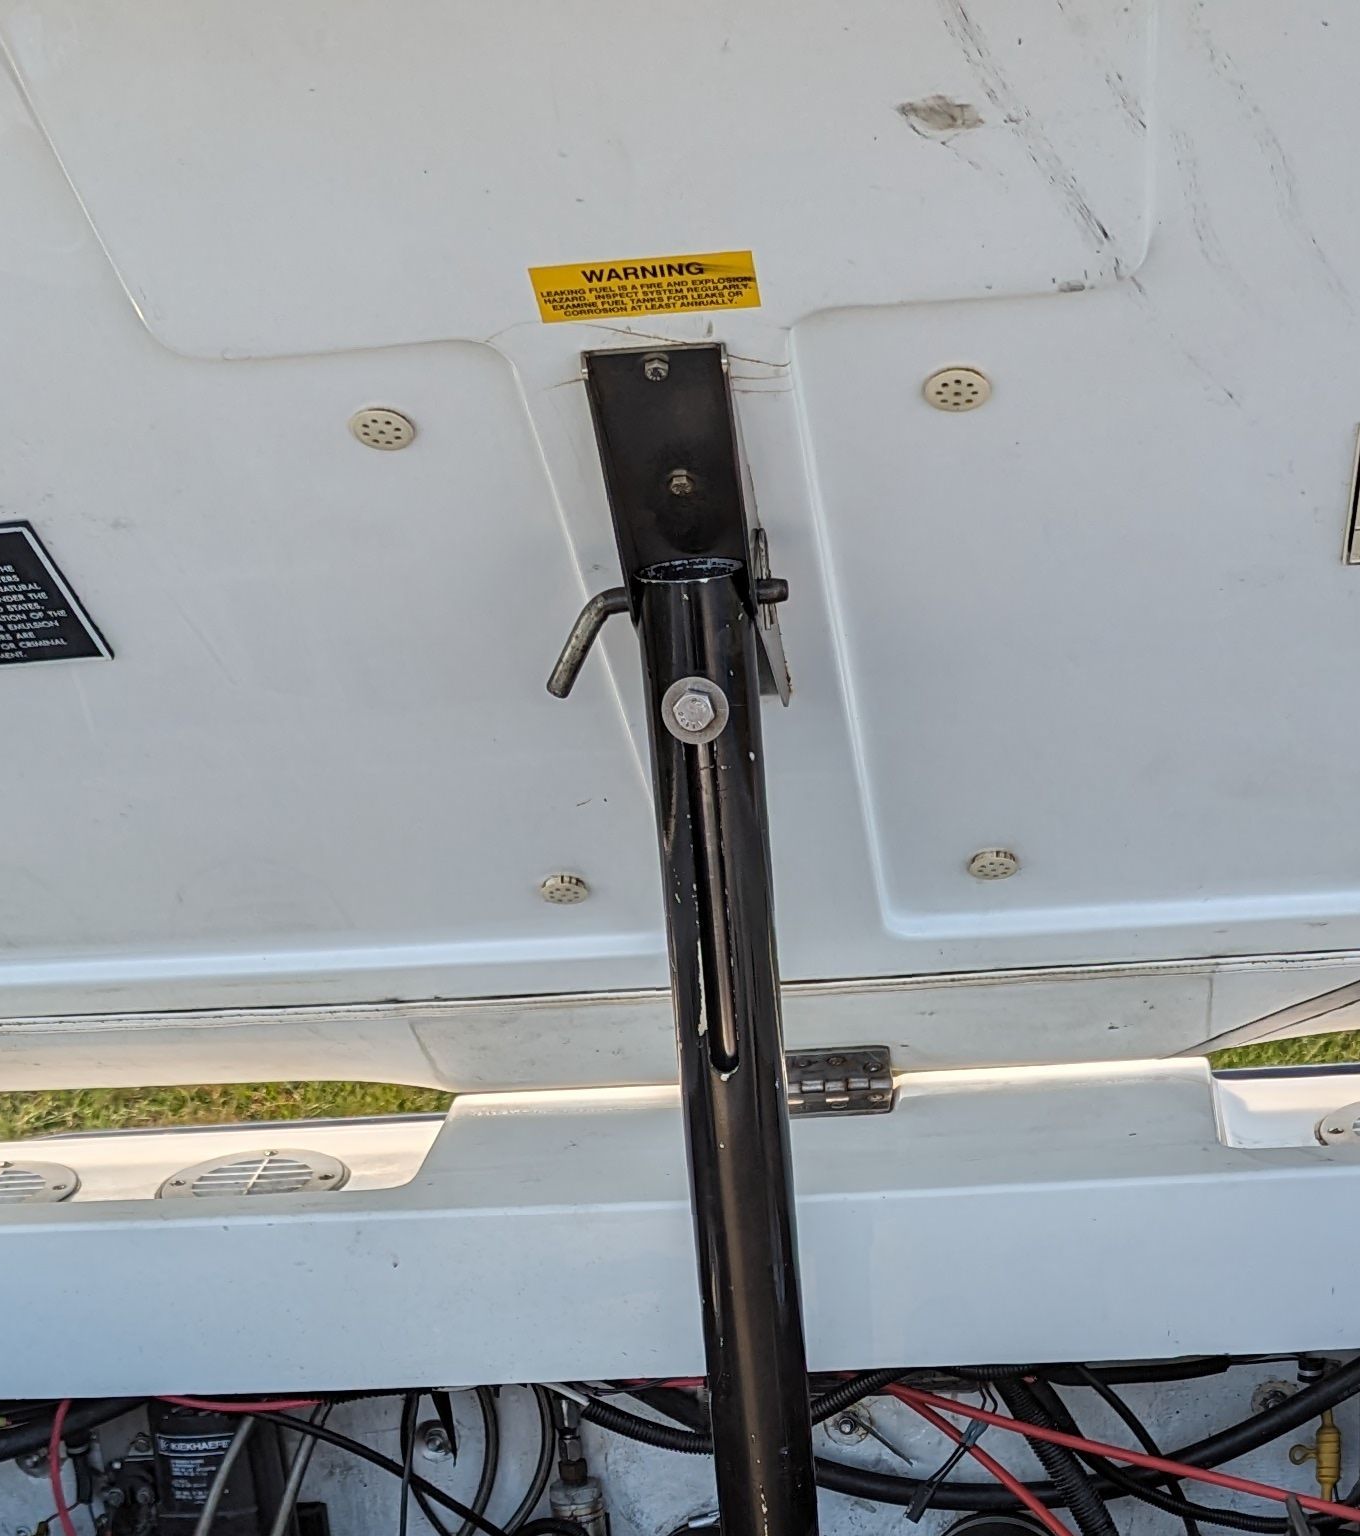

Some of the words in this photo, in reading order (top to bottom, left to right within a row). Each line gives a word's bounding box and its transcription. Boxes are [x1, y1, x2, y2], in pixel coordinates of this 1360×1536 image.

[582, 262, 705, 283] WARNING
[540, 289, 586, 297] LEAKING
[691, 276, 752, 286] EXPLOSION
[594, 292, 640, 300] INSPECT
[686, 283, 751, 293] REGULARLY.
[563, 307, 628, 316] CORROSION
[679, 298, 737, 307] ANNUALLY.
[6, 603, 44, 611] STATES,
[7, 621, 59, 630] EMULSION
